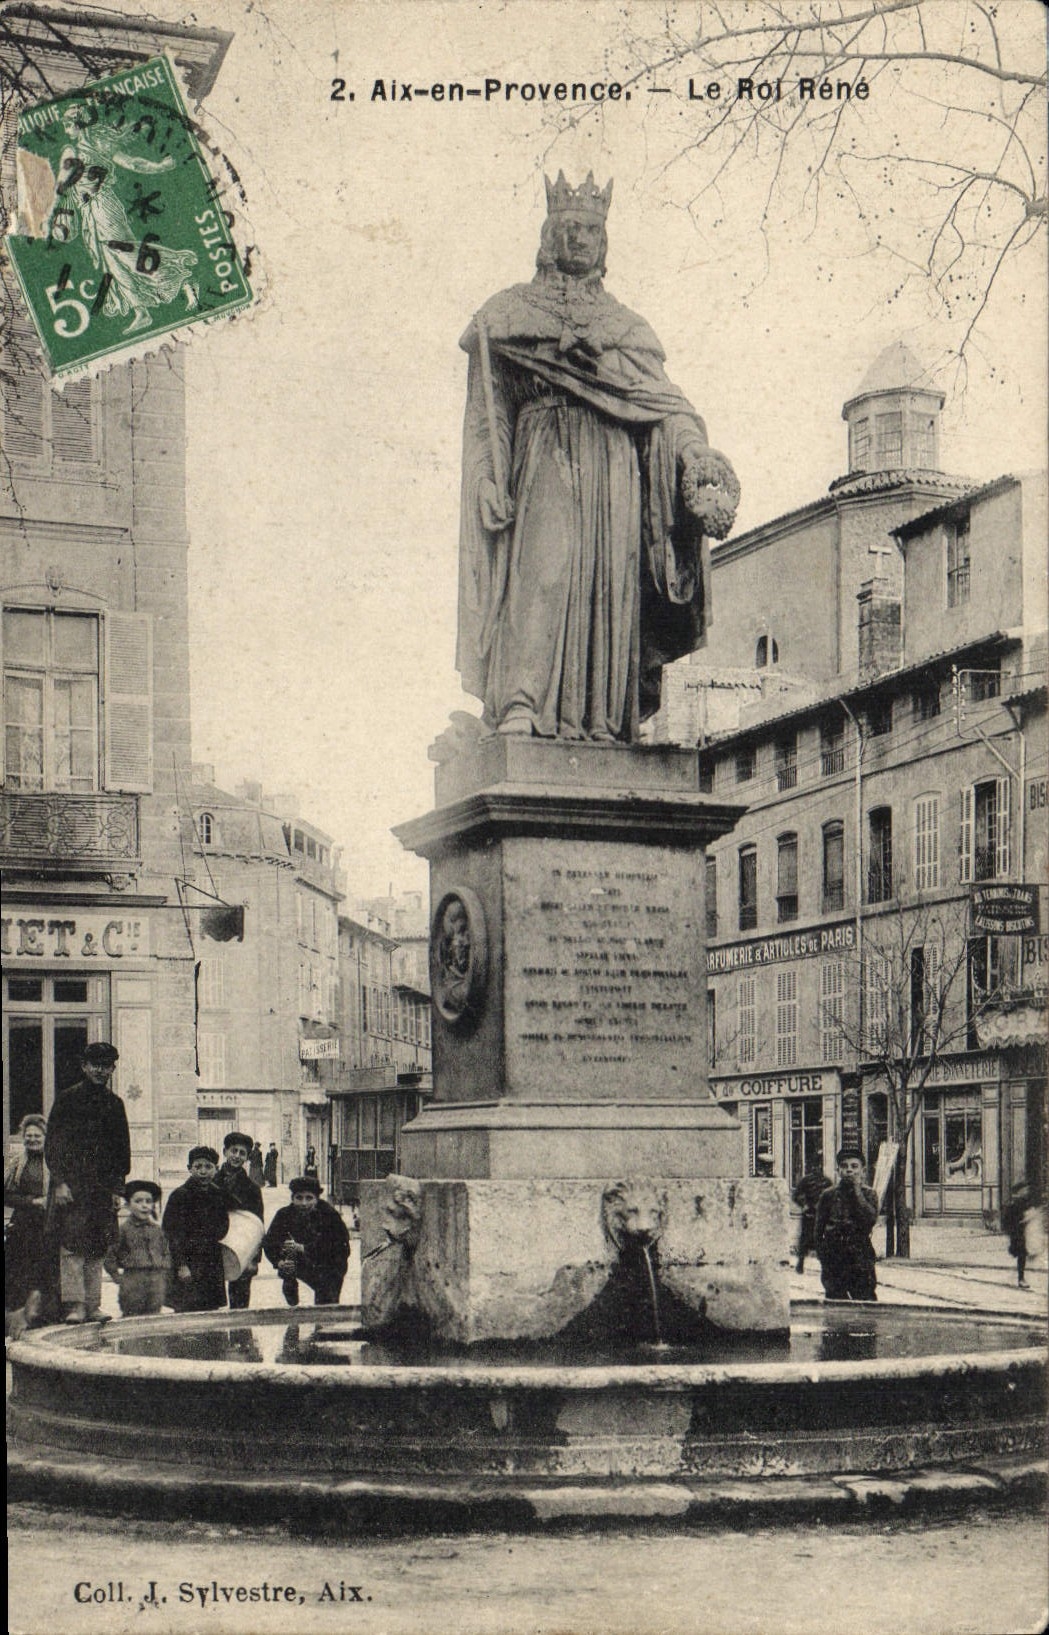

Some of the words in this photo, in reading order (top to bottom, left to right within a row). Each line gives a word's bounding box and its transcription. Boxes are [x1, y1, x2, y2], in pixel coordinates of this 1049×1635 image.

[195, 209, 239, 294] POSTES
[81, 932, 98, 956] &
[755, 949, 762, 961] &
[763, 935, 807, 962] ARTICLES
[820, 925, 854, 951] PARIS
[740, 1074, 823, 1096] COIFFURE
